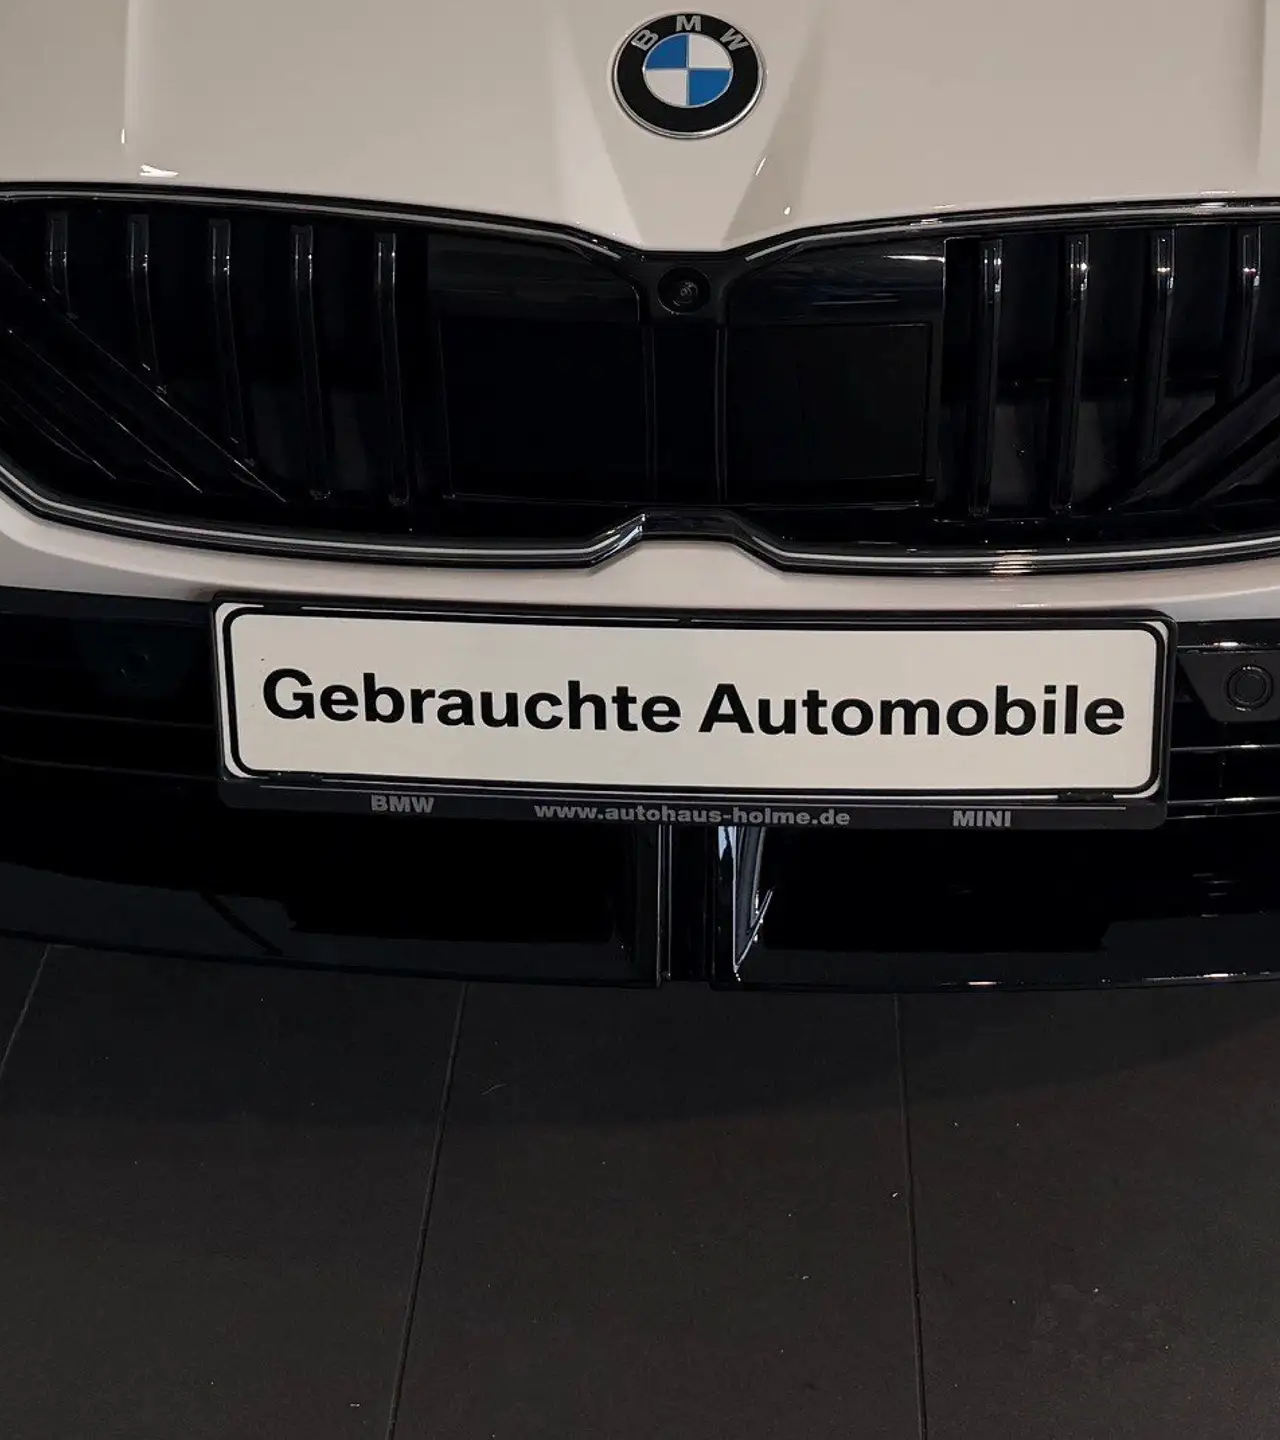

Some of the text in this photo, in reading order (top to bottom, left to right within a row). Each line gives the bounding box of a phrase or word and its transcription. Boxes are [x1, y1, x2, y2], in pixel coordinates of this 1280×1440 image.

[631, 15, 749, 51] BMW
[262, 668, 1126, 737] Gebrauchte Automobile
[370, 794, 1012, 827] BMW www.autohaus-holme.de MINI
